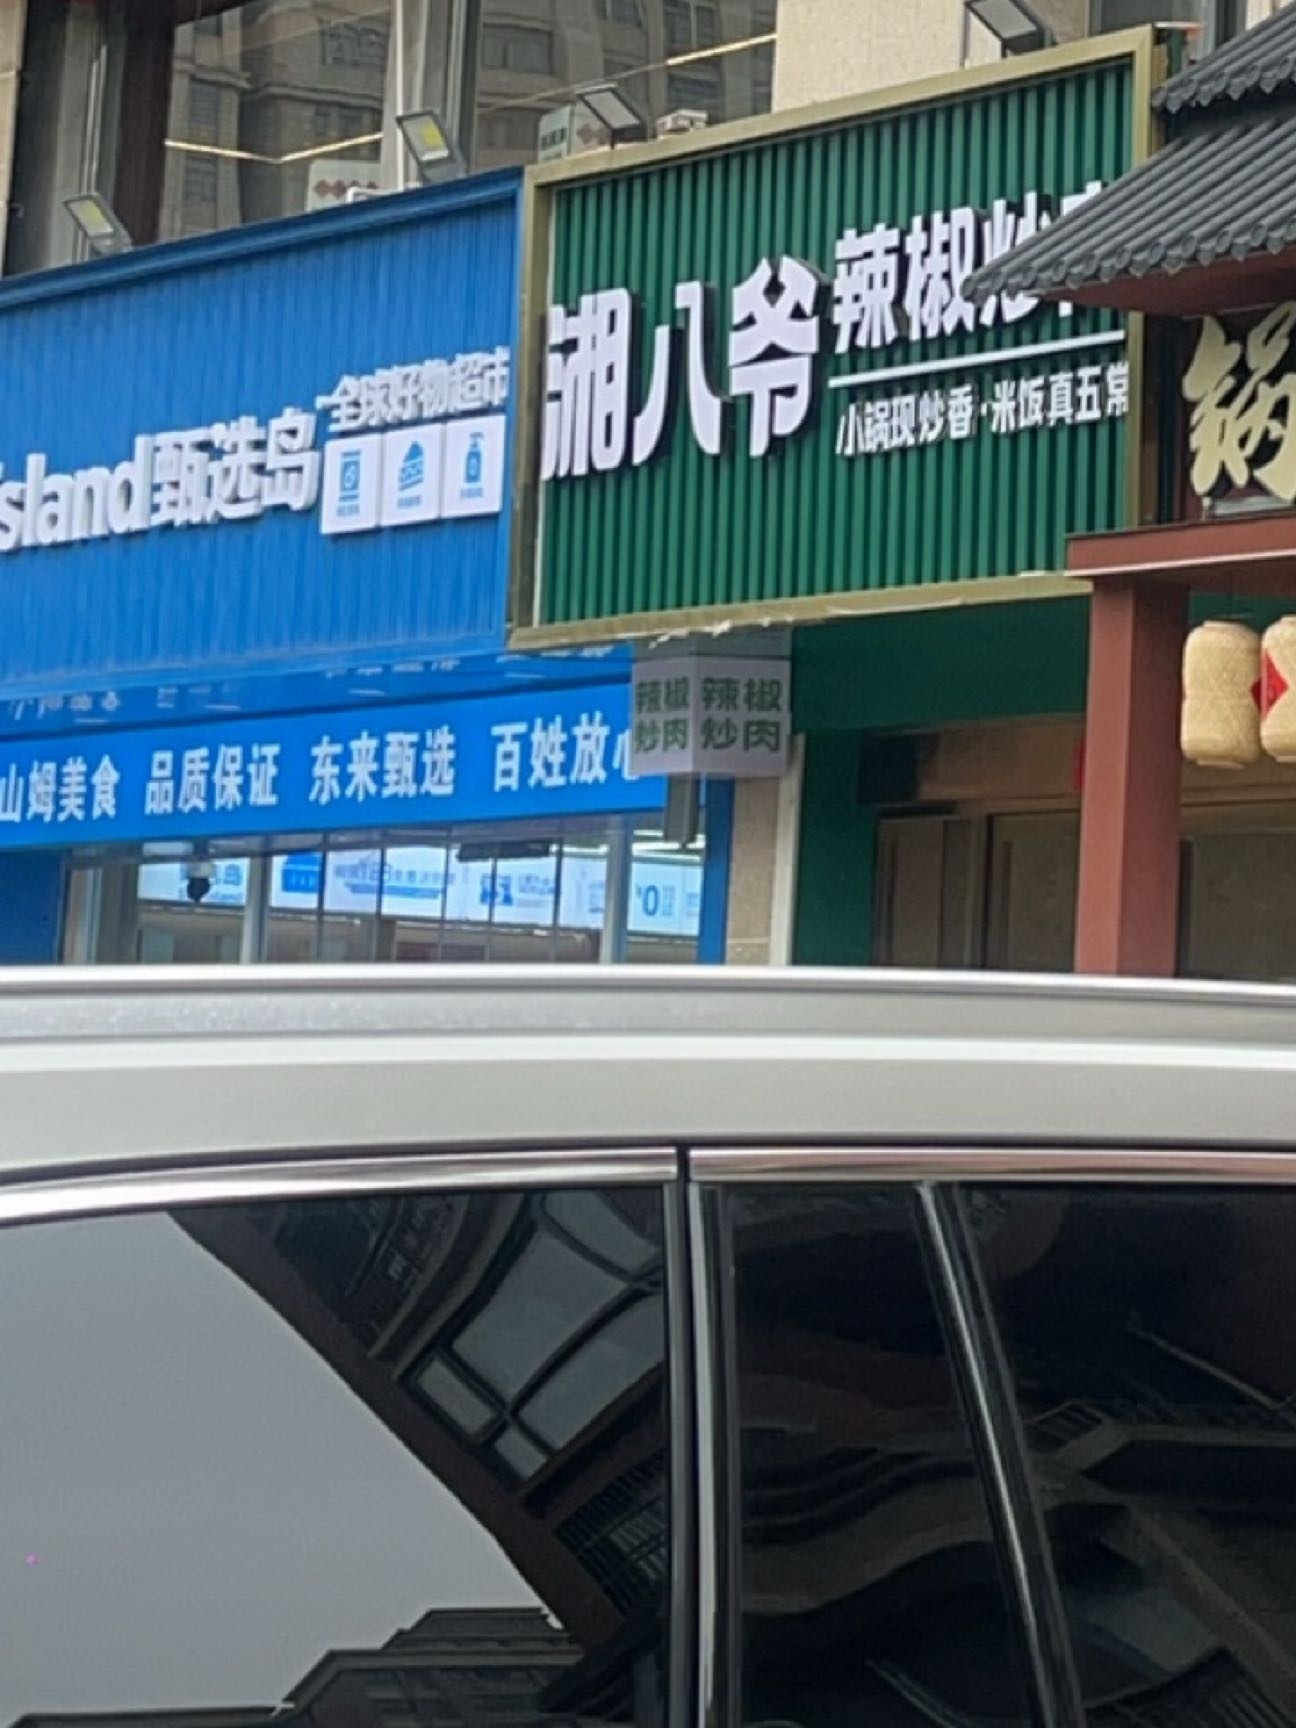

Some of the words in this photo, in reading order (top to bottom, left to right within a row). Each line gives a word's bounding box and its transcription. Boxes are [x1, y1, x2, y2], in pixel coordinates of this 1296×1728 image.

[834, 180, 1102, 354] 辣椒炒
[541, 255, 820, 480] 湘八爷
[0, 434, 154, 552] sland
[703, 677, 782, 712] 辣椒
[703, 718, 781, 752] 炒肉
[144, 743, 281, 816] 品质保证
[309, 725, 455, 806] 东来甄选
